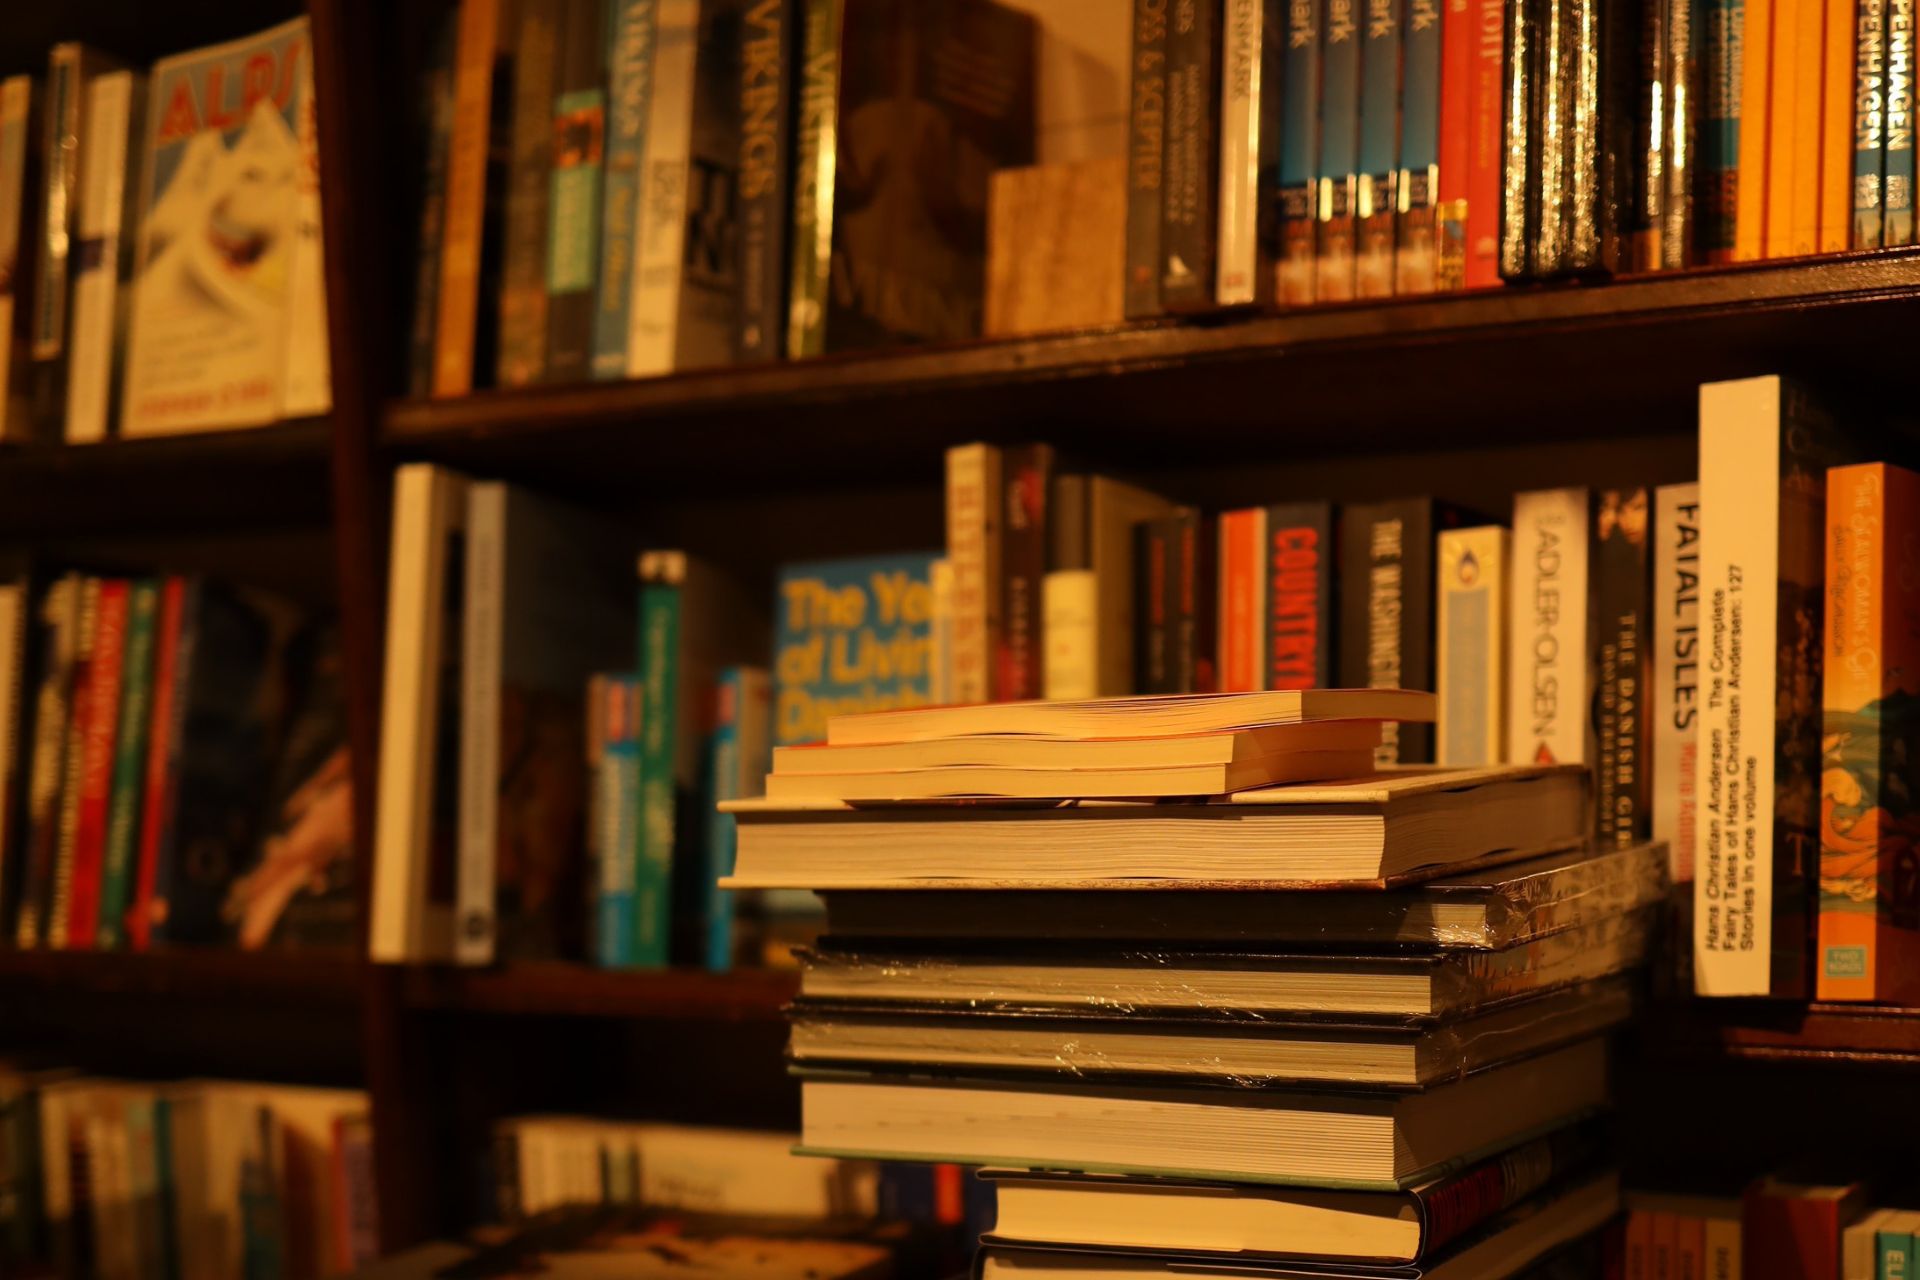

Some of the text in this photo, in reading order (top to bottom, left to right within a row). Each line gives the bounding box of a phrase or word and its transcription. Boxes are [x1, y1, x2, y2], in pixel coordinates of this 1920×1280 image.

[740, 0, 781, 199] VIKINGS
[1289, 0, 1317, 50] ark
[779, 630, 933, 684] of Livin
[783, 572, 932, 630] The Ye
[1368, 564, 1402, 690] WASHINGTO
[1532, 528, 1563, 737] ADLER-OLSEN
[1674, 626, 1699, 733] ISLES
[1615, 612, 1637, 849] THE DANISH GIR
[1704, 587, 1726, 951] Hans Christian Andersen The Complete
[1722, 563, 1743, 952] Fairy Tales of Hans Christian Andersen: 127
[1739, 756, 1757, 952] Stories in one volume
